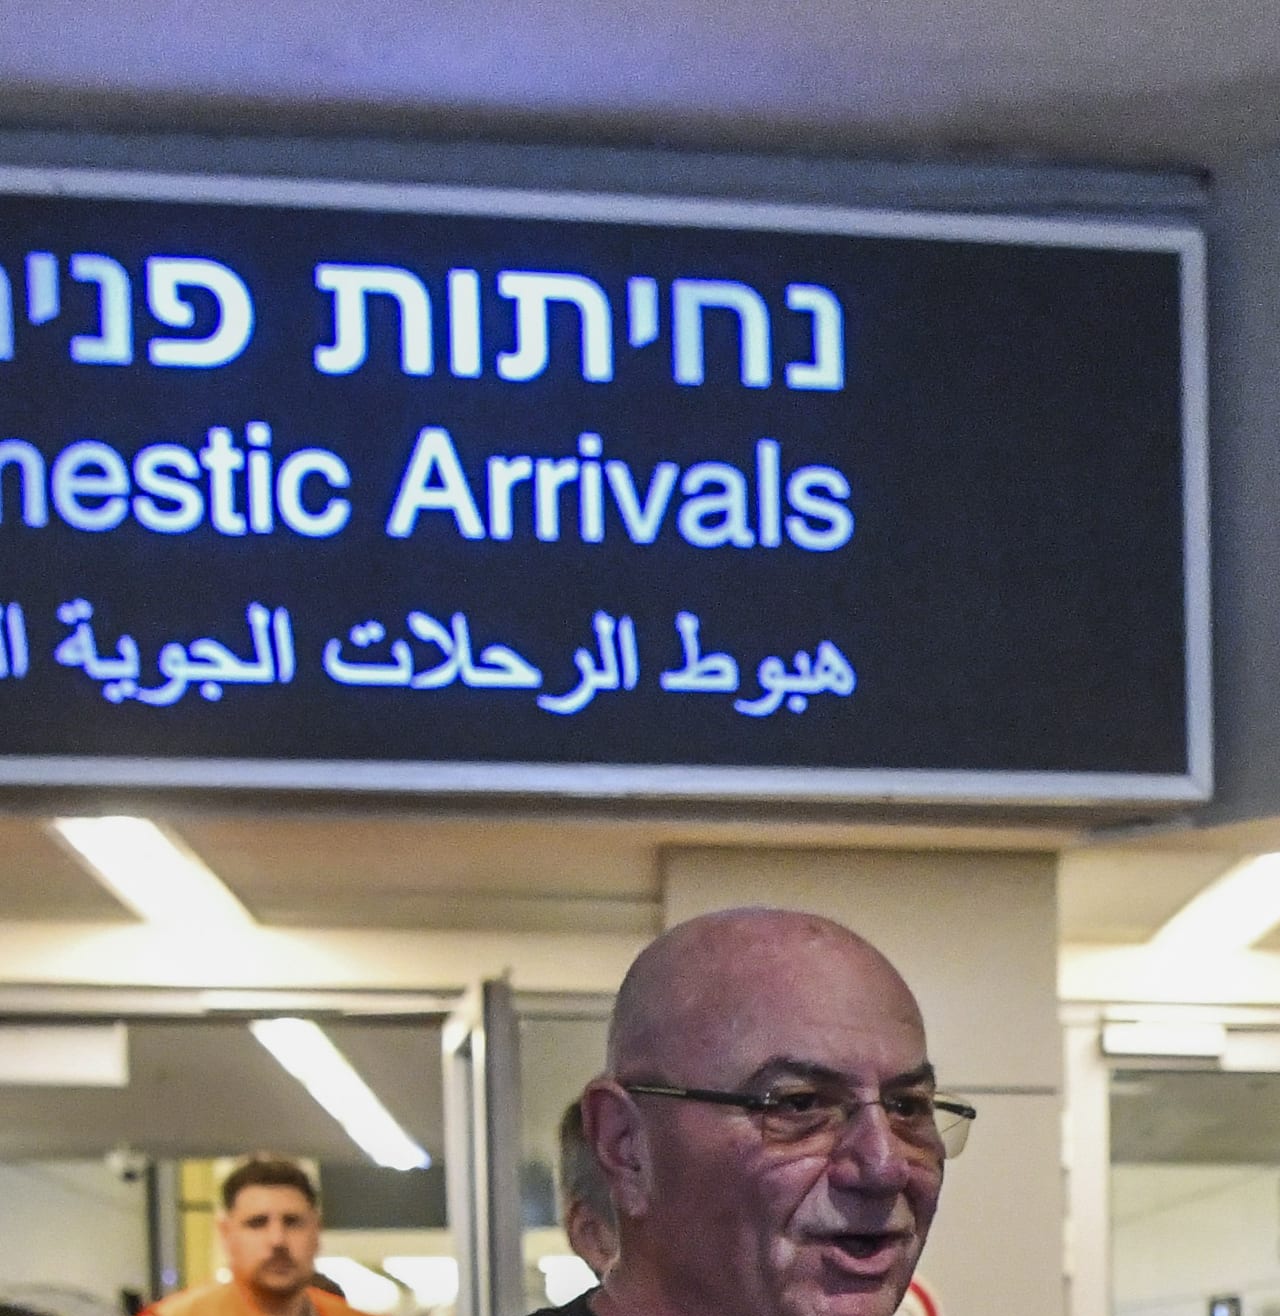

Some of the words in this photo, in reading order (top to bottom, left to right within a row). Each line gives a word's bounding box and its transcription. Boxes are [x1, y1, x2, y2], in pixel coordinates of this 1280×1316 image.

[0, 252, 254, 368] פני
[314, 262, 845, 390] נחיתות
[386, 427, 855, 552] Arrivals
[55, 598, 295, 706] الجوية
[323, 610, 639, 715] الرحلات
[660, 611, 856, 716] هبوط
